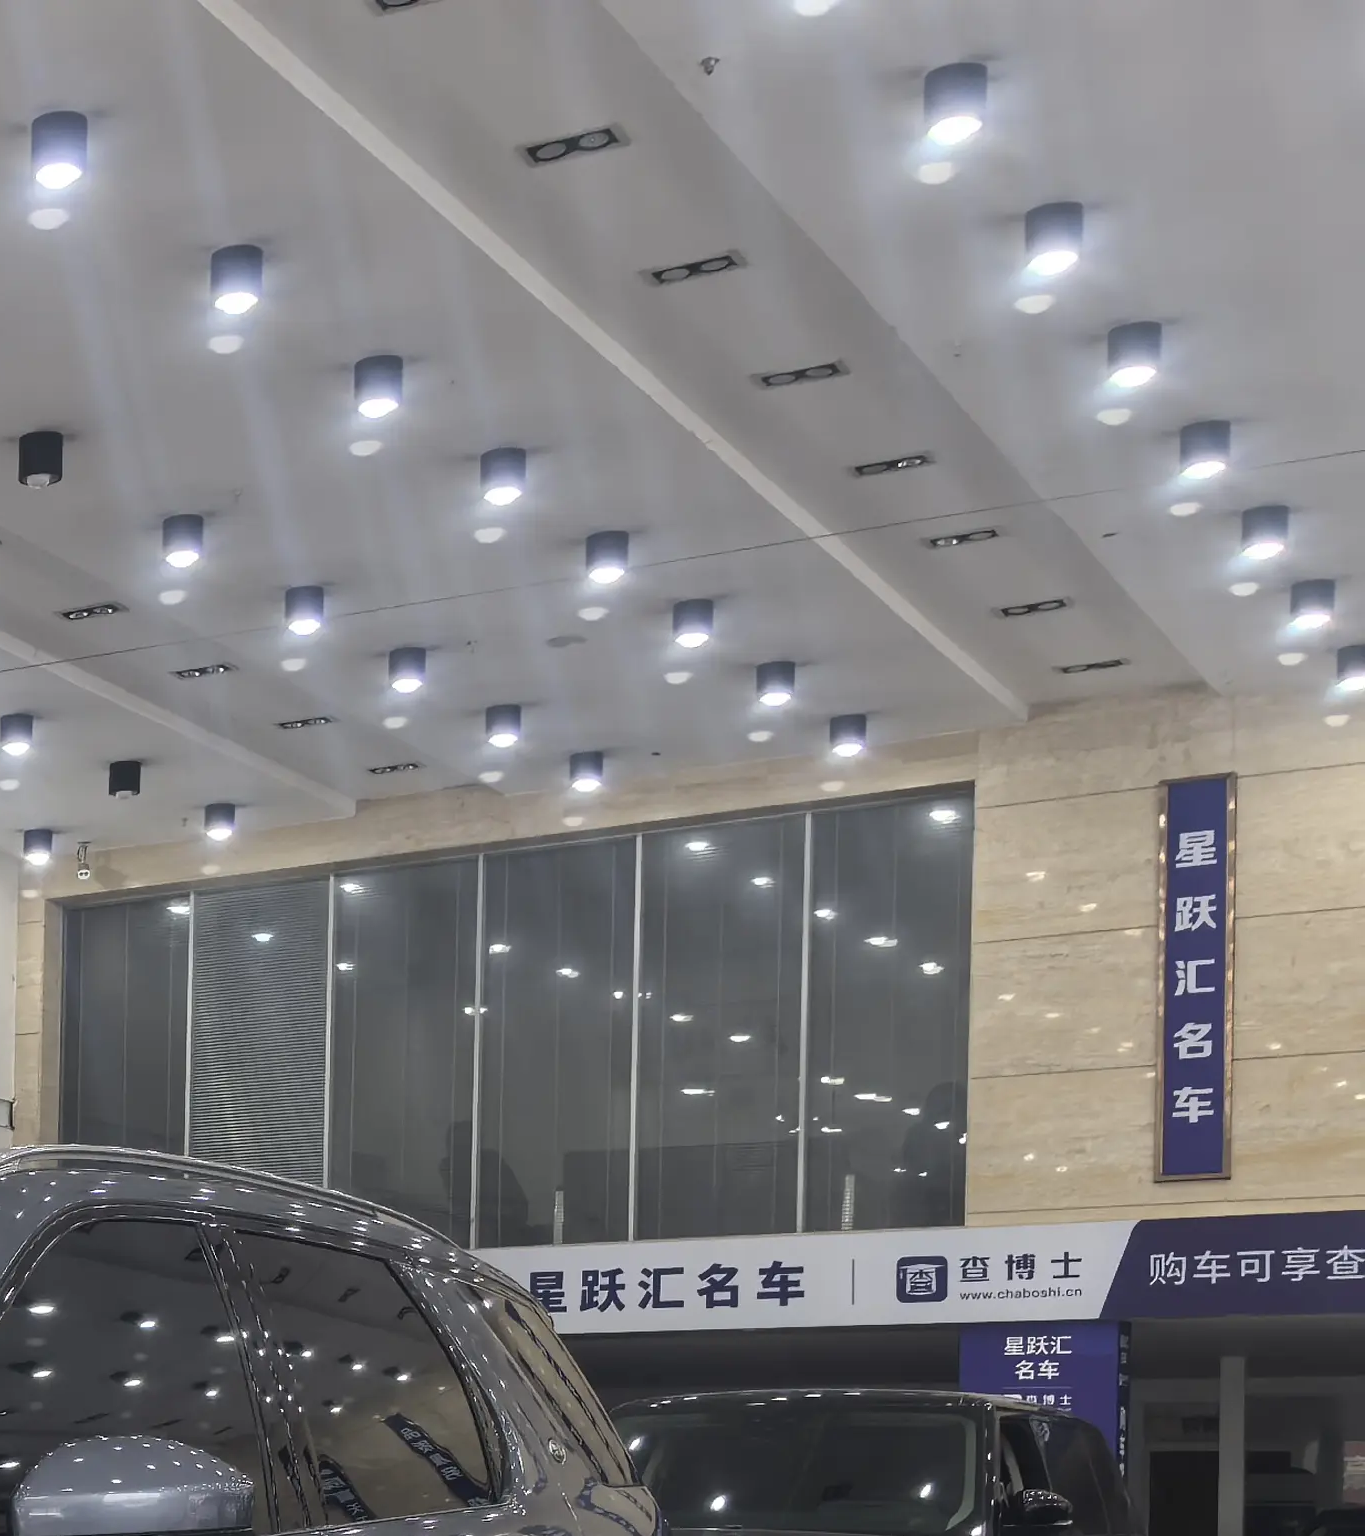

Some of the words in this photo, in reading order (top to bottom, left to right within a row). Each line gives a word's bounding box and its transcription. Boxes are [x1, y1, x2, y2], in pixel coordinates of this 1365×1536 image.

[1171, 829, 1218, 1124] 星跃汇名车
[959, 1251, 1083, 1283] 查博士
[529, 1260, 806, 1314] 星跃汇名车
[959, 1286, 1083, 1301] www.chaboshi.cn
[1003, 1335, 1073, 1356] 星跃汇
[1014, 1359, 1060, 1380] 名车
